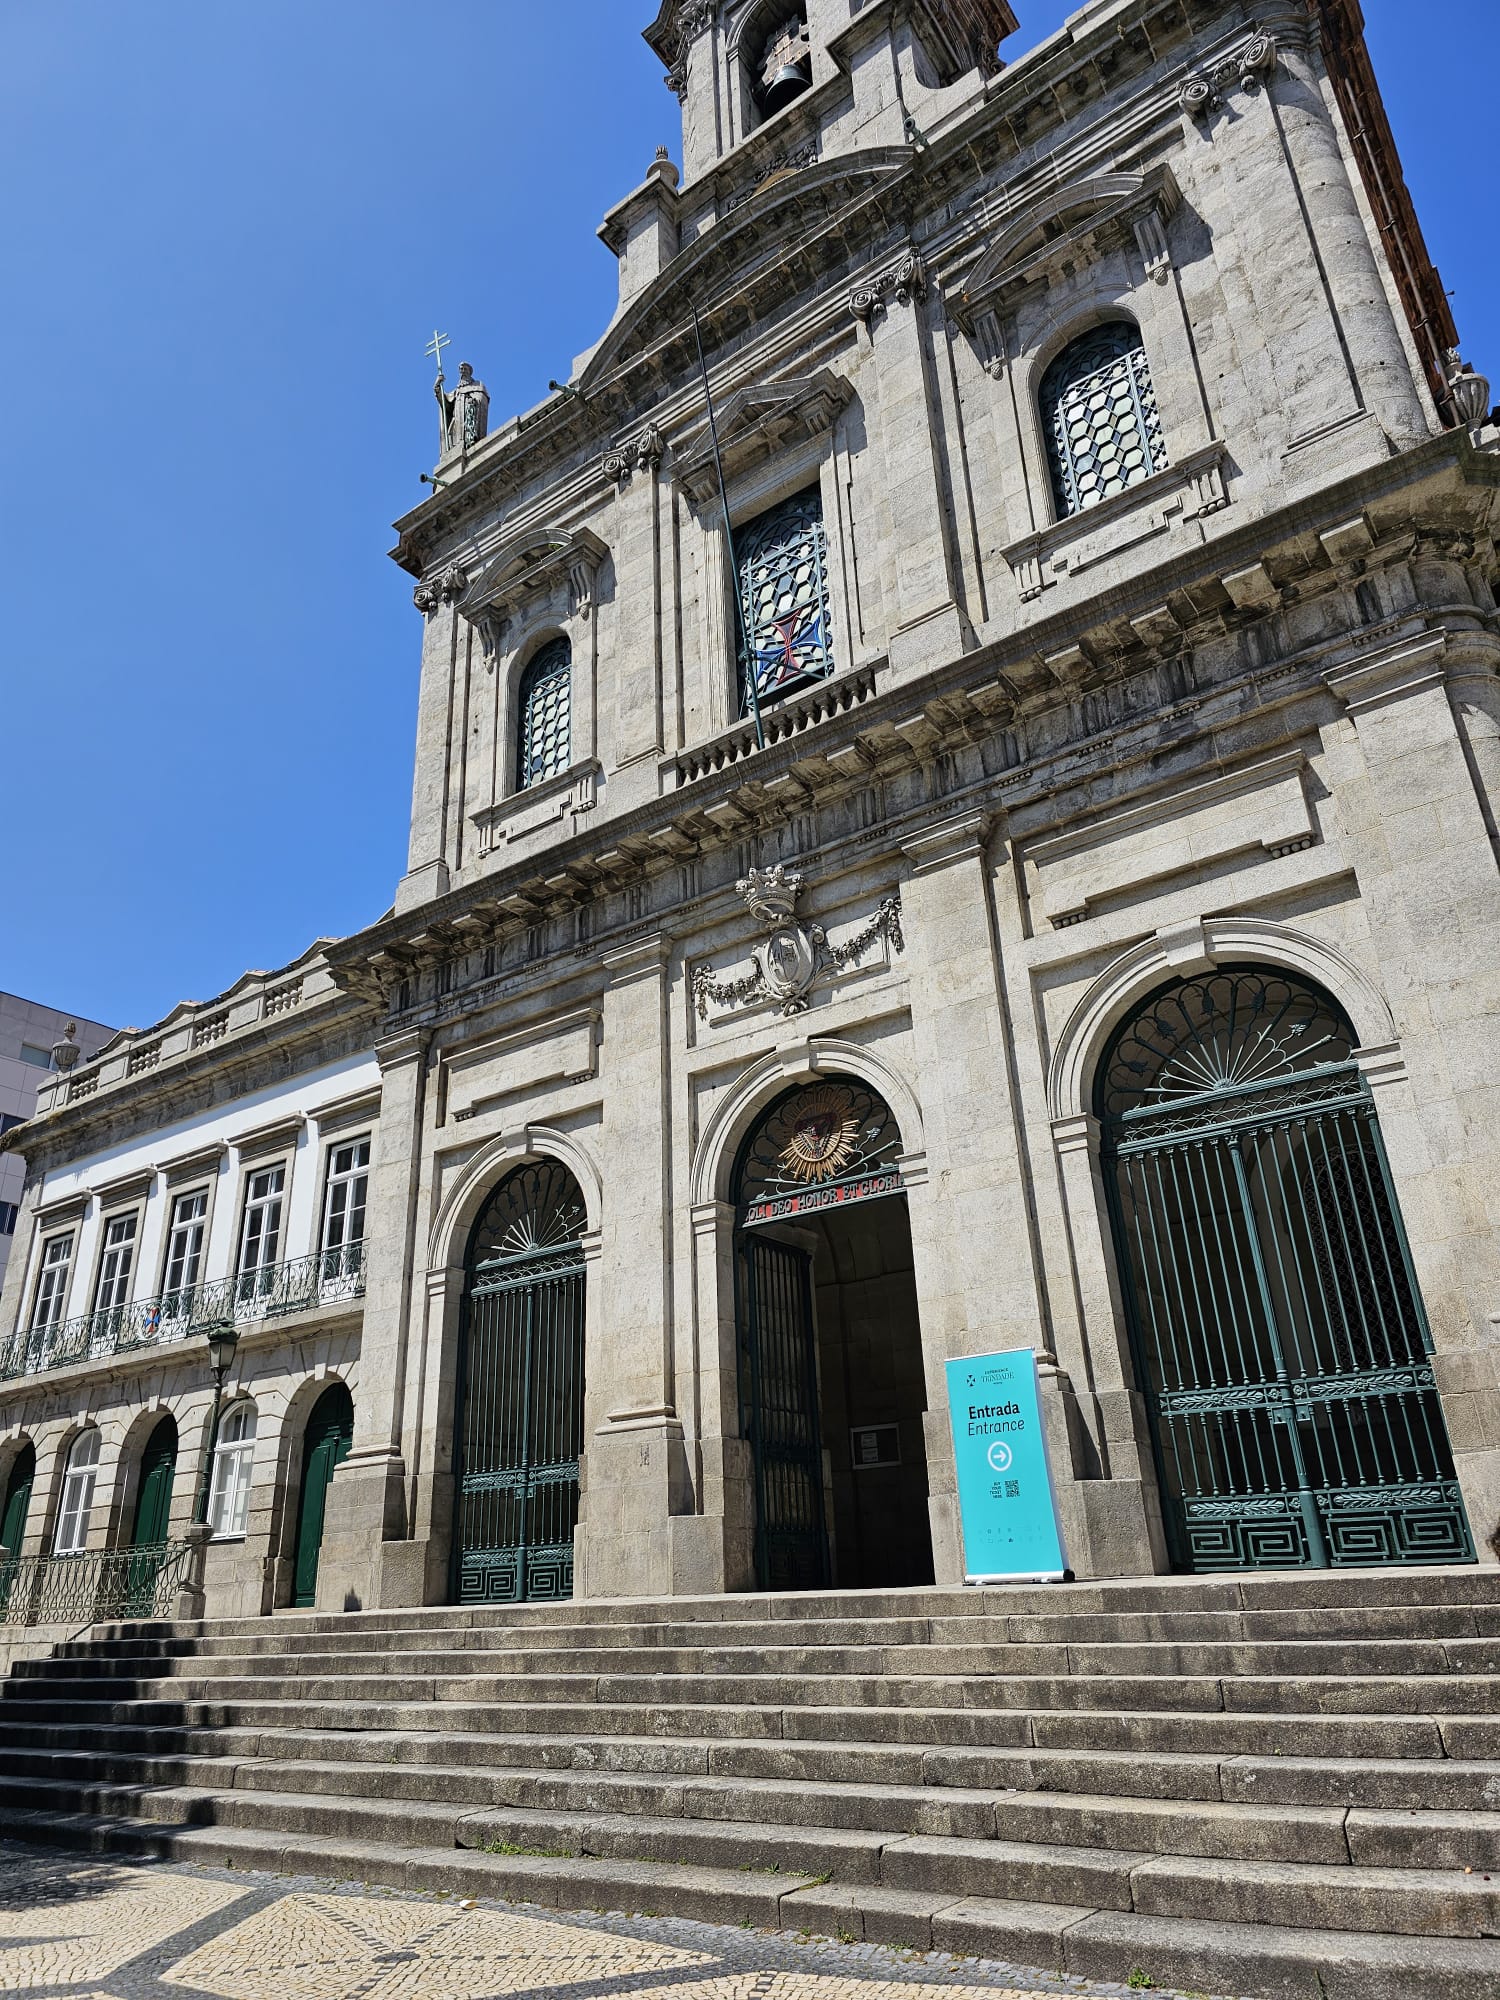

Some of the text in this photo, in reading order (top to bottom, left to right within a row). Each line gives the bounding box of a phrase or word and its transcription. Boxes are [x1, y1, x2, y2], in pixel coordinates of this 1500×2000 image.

[745, 1204, 766, 1222] OLI
[771, 1199, 792, 1216] DEO
[797, 1188, 838, 1211] HONOR
[843, 1183, 858, 1199] ET
[968, 1400, 1021, 1420] Entrada
[968, 1419, 1025, 1437] Entrance
